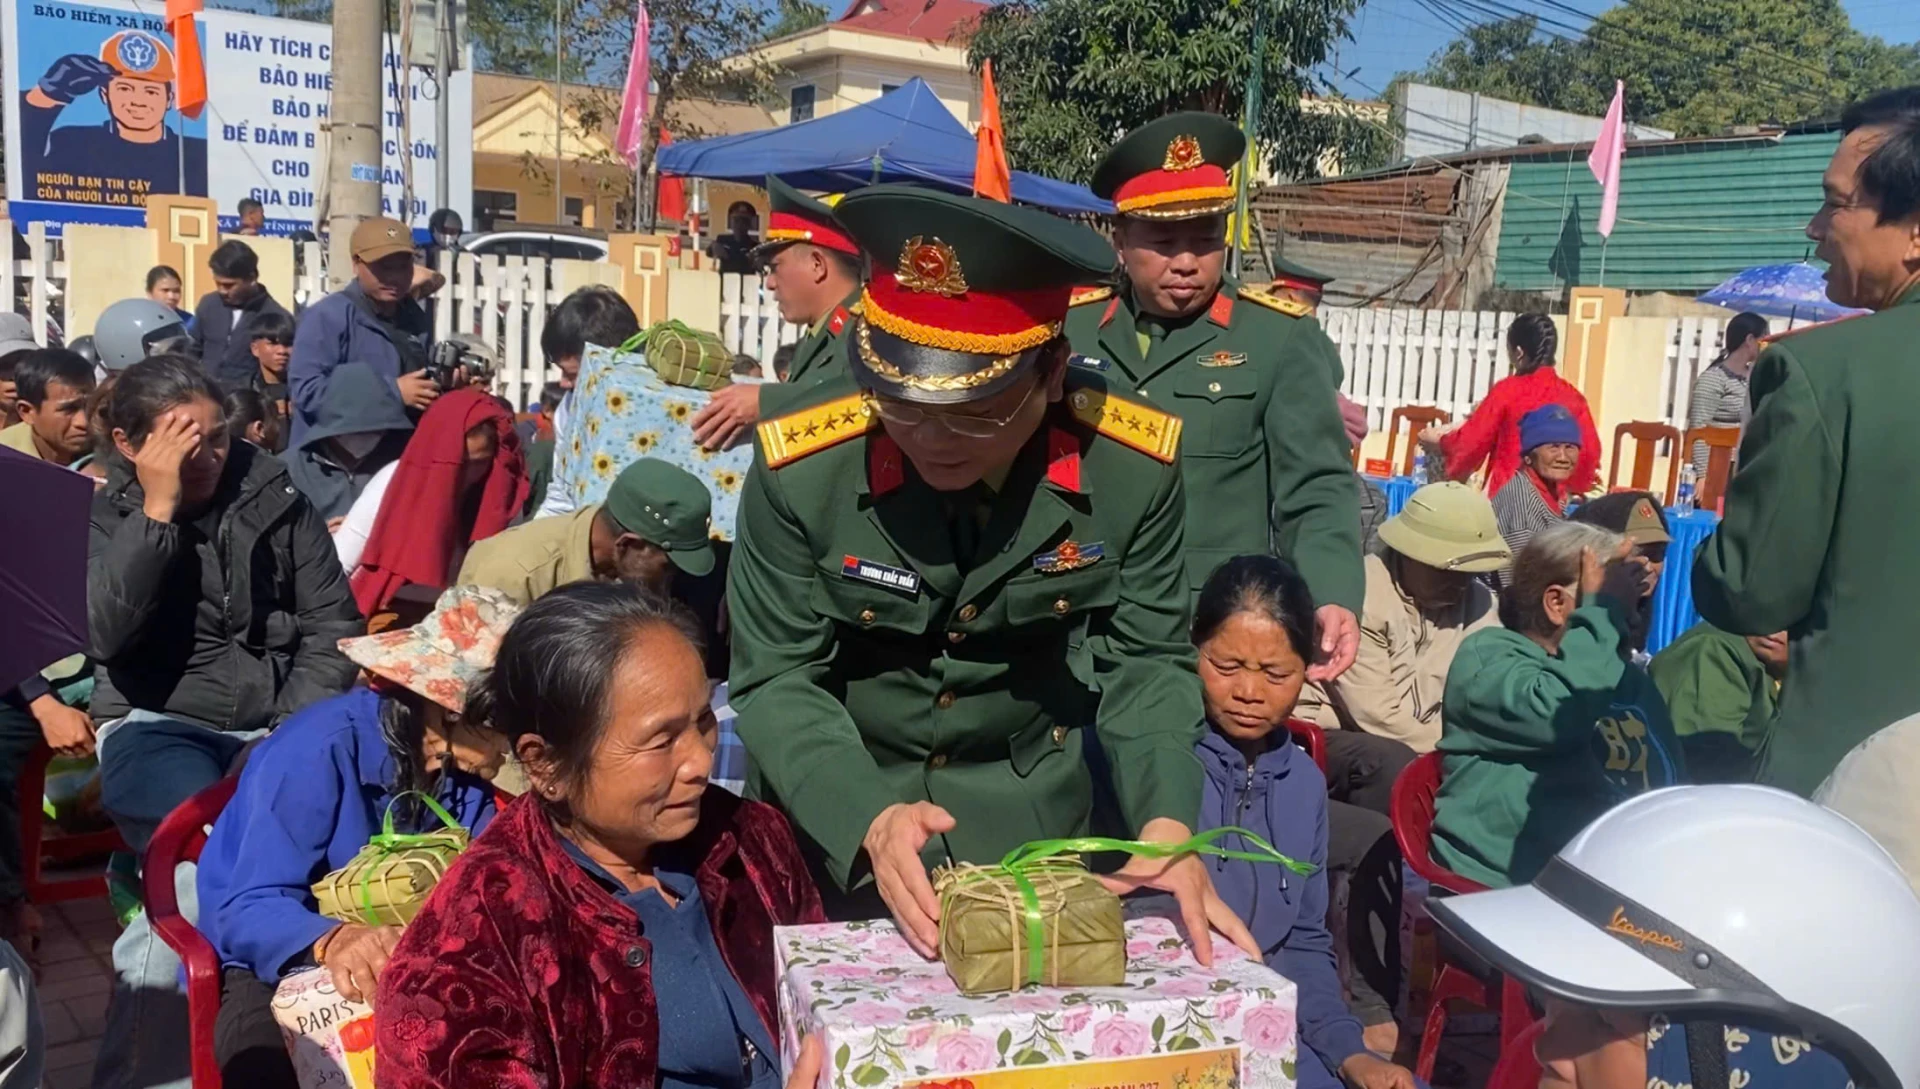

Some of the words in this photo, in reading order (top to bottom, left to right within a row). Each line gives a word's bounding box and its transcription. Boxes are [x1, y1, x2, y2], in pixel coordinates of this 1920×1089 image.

[34, 4, 65, 19] BẢO
[225, 30, 263, 53] HÃY
[269, 35, 312, 59] TÍCH
[259, 63, 298, 87] BẢO
[272, 95, 310, 118] BẢO
[223, 119, 249, 143] ĐỂ
[254, 123, 298, 147] ĐẢM
[272, 159, 310, 178] CHO
[37, 172, 74, 187] NGƯỜI
[78, 176, 102, 188] BẠN
[106, 178, 124, 190] TIN
[37, 185, 62, 200] CỦA
[66, 189, 102, 203] NGƯỜI
[106, 193, 128, 204] LAO
[250, 188, 281, 206] GIA
[1606, 905, 1687, 953] Vespa
[296, 1000, 354, 1036] PARIS
